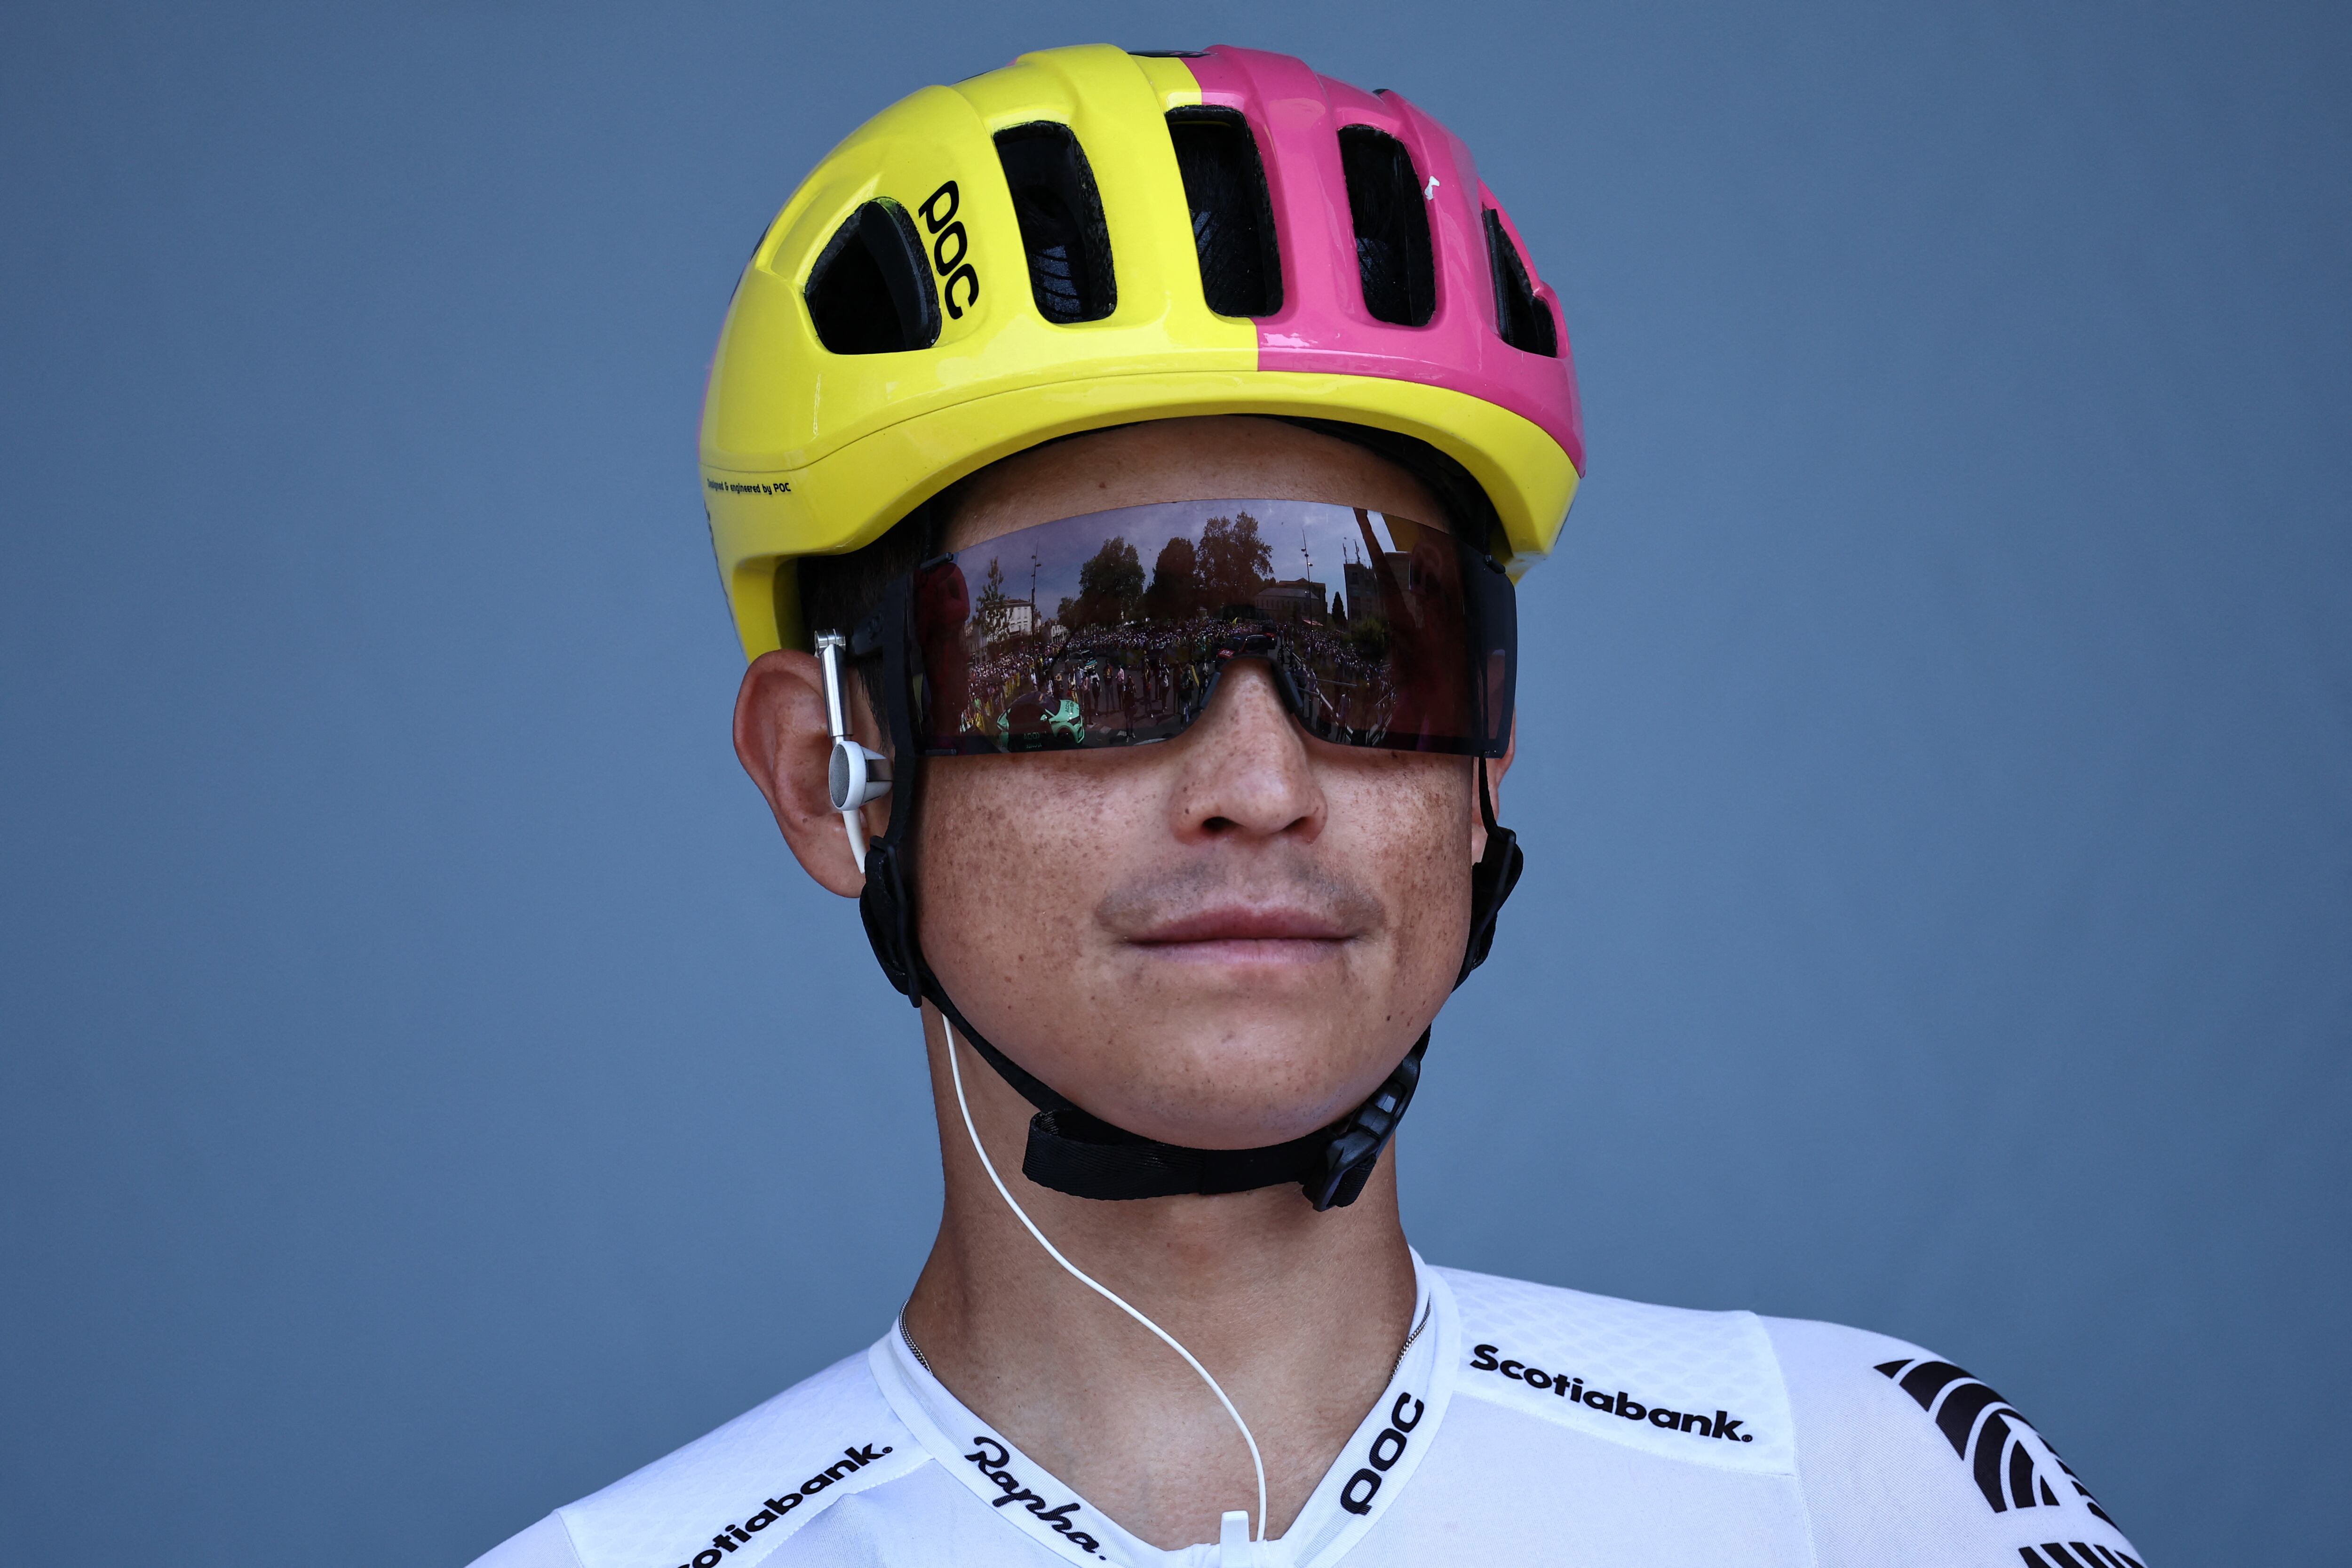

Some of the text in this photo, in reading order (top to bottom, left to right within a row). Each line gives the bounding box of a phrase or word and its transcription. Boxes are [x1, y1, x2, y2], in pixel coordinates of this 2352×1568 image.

[918, 180, 979, 320] POC
[730, 483, 761, 494] engineered
[762, 484, 772, 495] by
[773, 483, 791, 493] POC
[1341, 1392, 1424, 1515] POC
